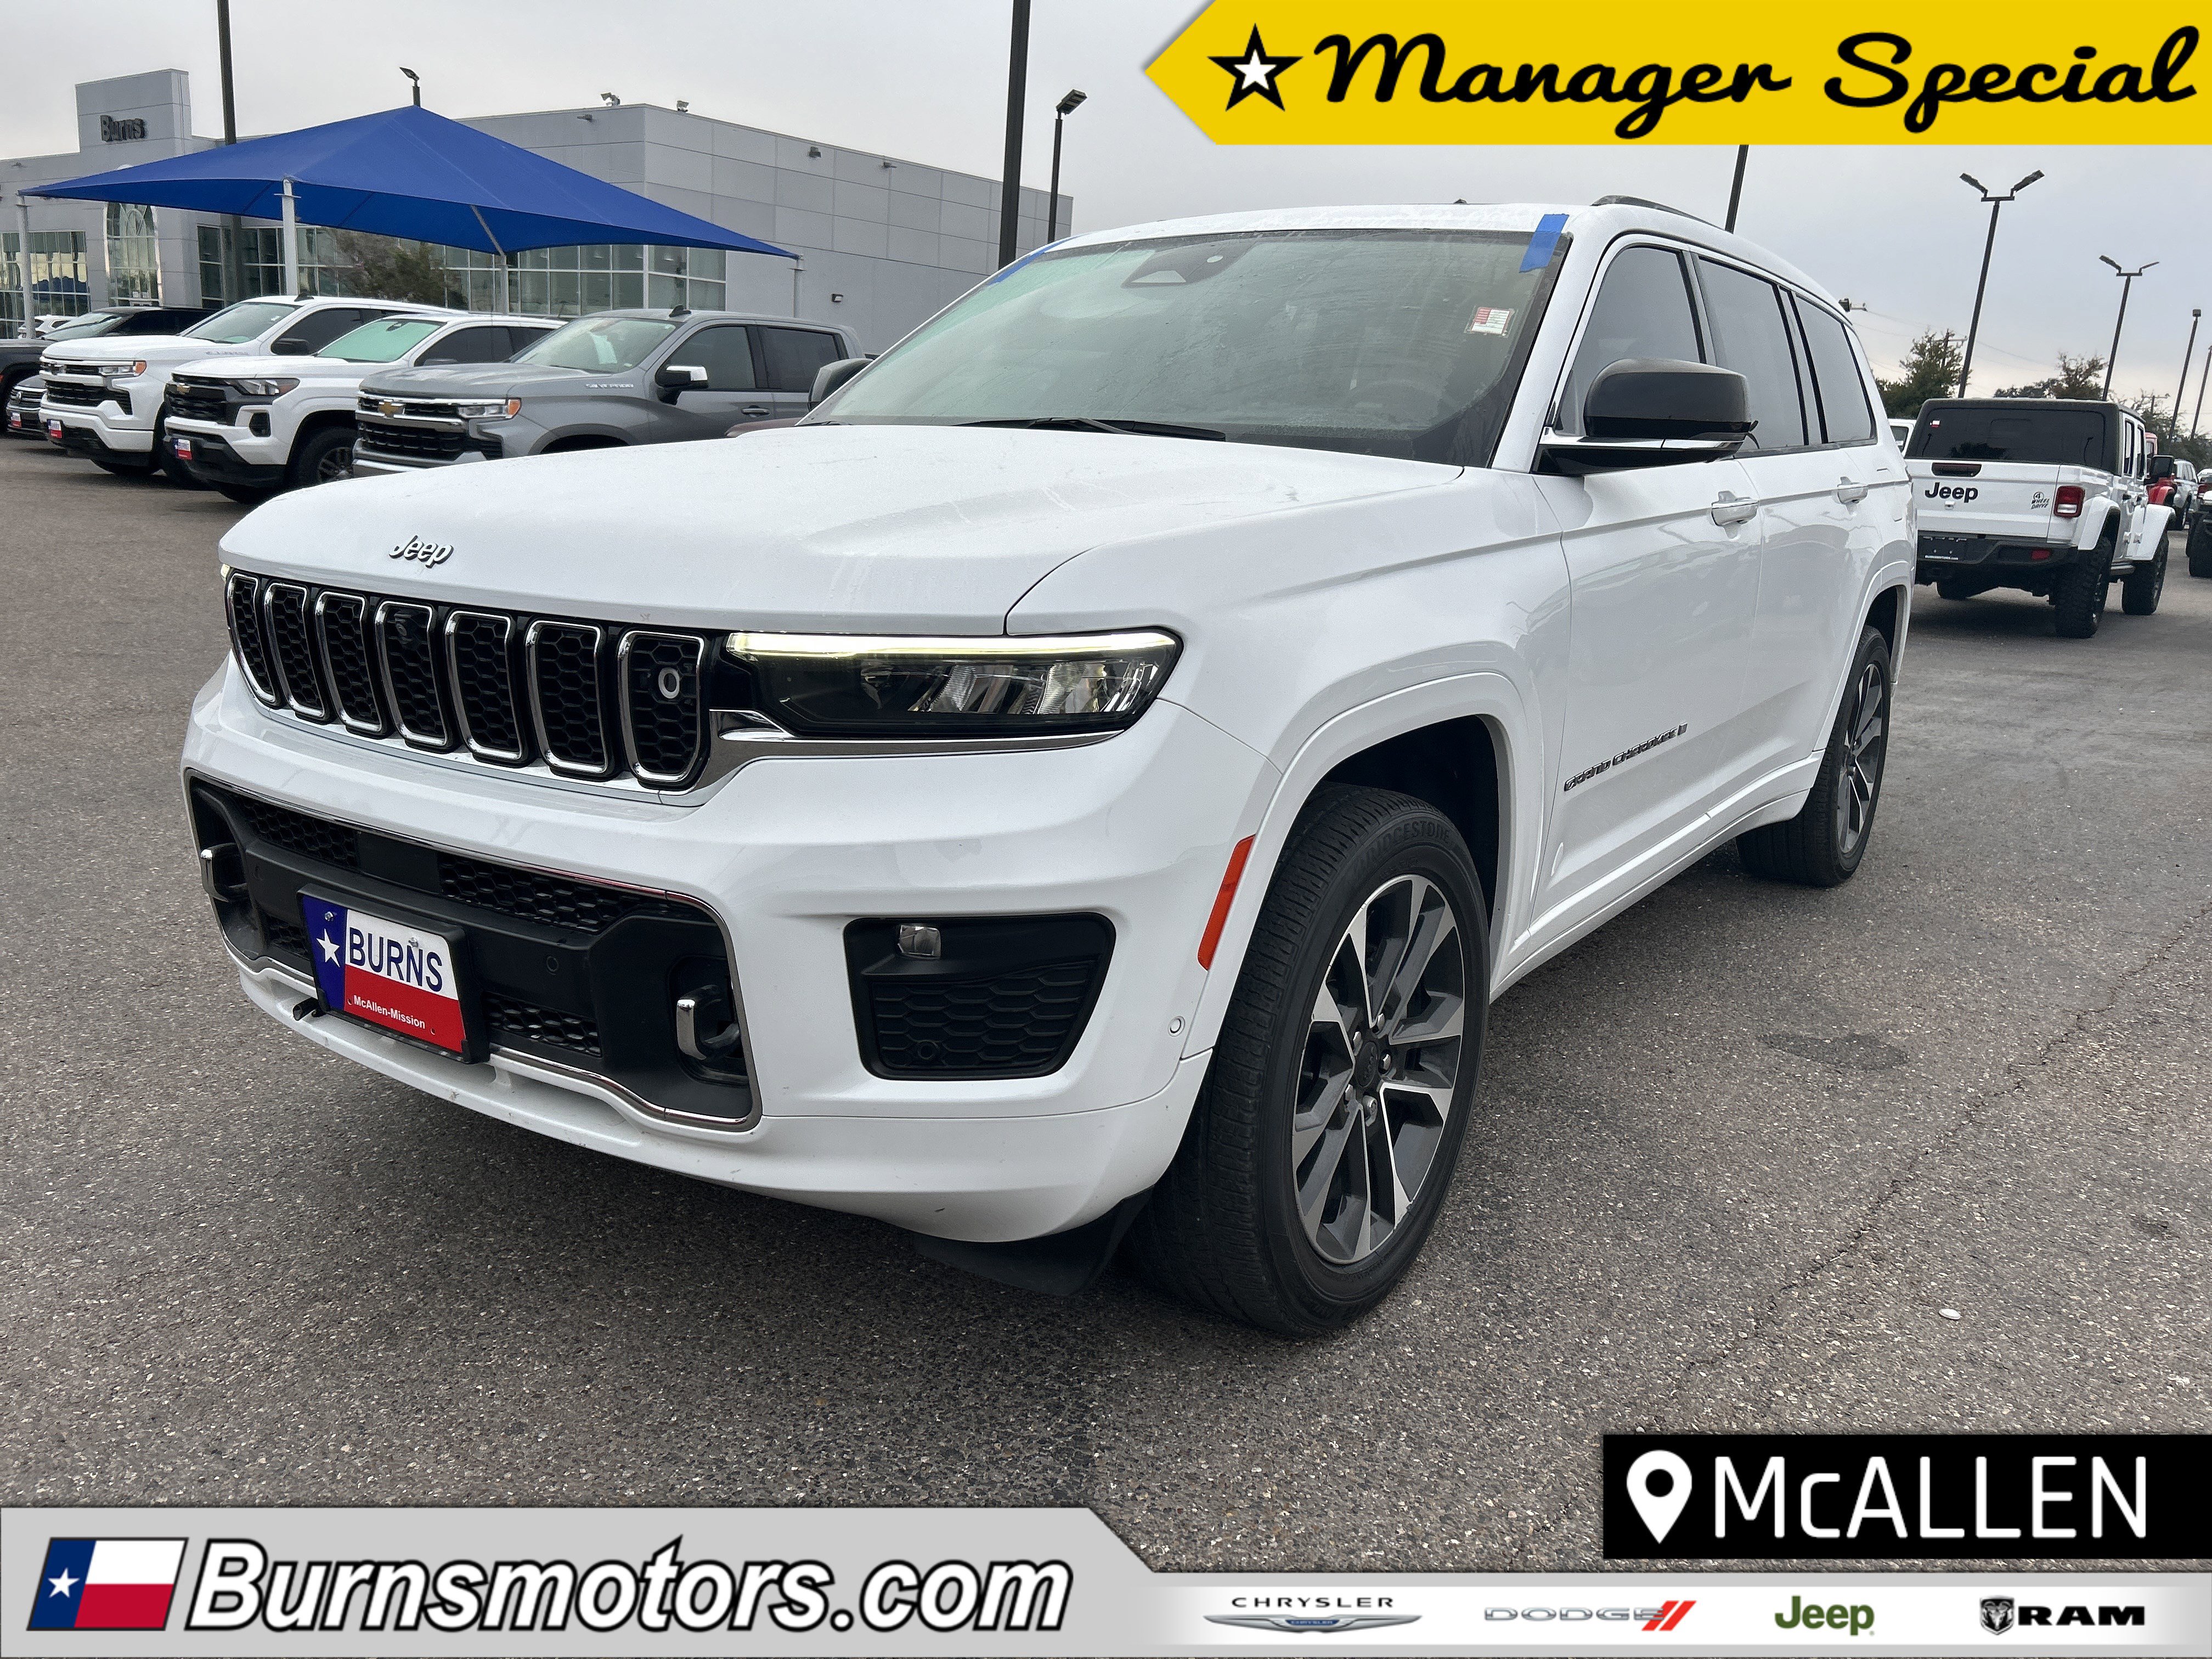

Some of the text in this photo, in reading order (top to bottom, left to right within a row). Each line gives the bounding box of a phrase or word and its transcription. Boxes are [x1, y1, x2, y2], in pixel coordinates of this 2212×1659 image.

[100, 115, 144, 142] Burns
[1925, 482, 1978, 503] Jeep
[389, 535, 454, 568] Jeep
[1564, 759, 1611, 791] GRAND
[1612, 727, 1677, 766] CHEROKEE
[349, 927, 442, 992] BURNS
[354, 995, 426, 1029] McAllen-Mission
